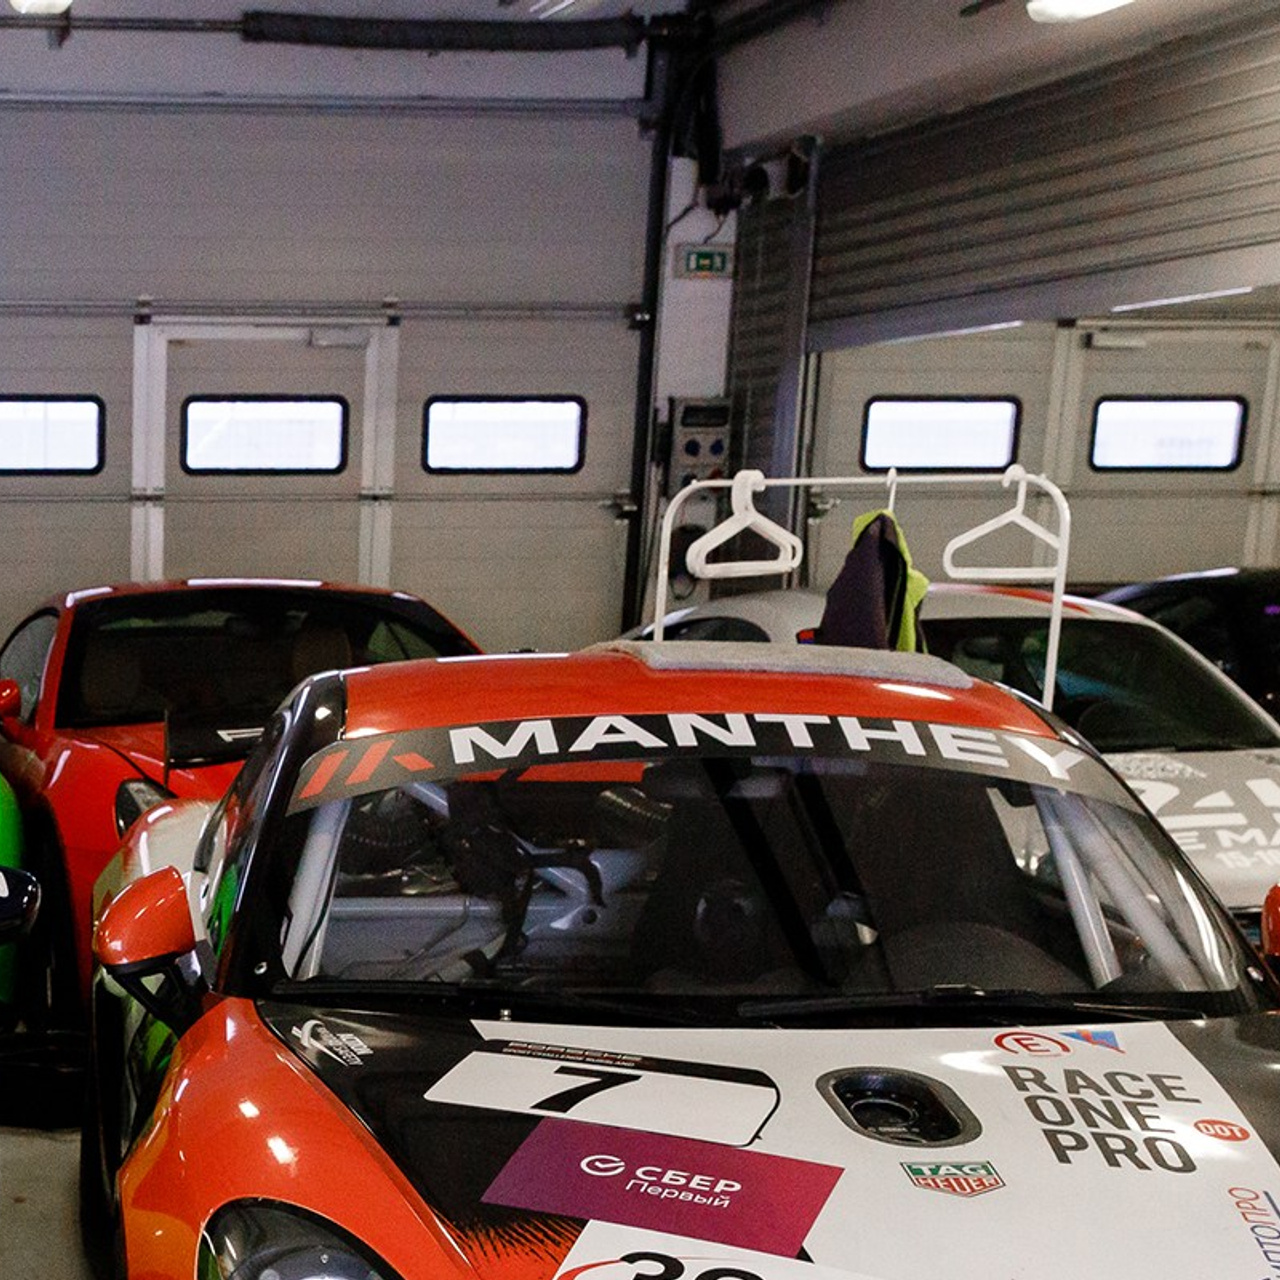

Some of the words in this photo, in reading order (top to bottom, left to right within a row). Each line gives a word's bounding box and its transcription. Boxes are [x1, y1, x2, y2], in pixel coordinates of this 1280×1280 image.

[449, 712, 1083, 781] MANTHEY
[530, 1065, 643, 1114] 7
[1002, 1065, 1202, 1104] RACE
[1024, 1094, 1176, 1134] ONE
[1199, 1123, 1243, 1139] DOT
[911, 1165, 986, 1176] TAG
[1041, 1128, 1198, 1174] PRO
[625, 1179, 731, 1208] Первый
[634, 1166, 742, 1194] СБЕР
